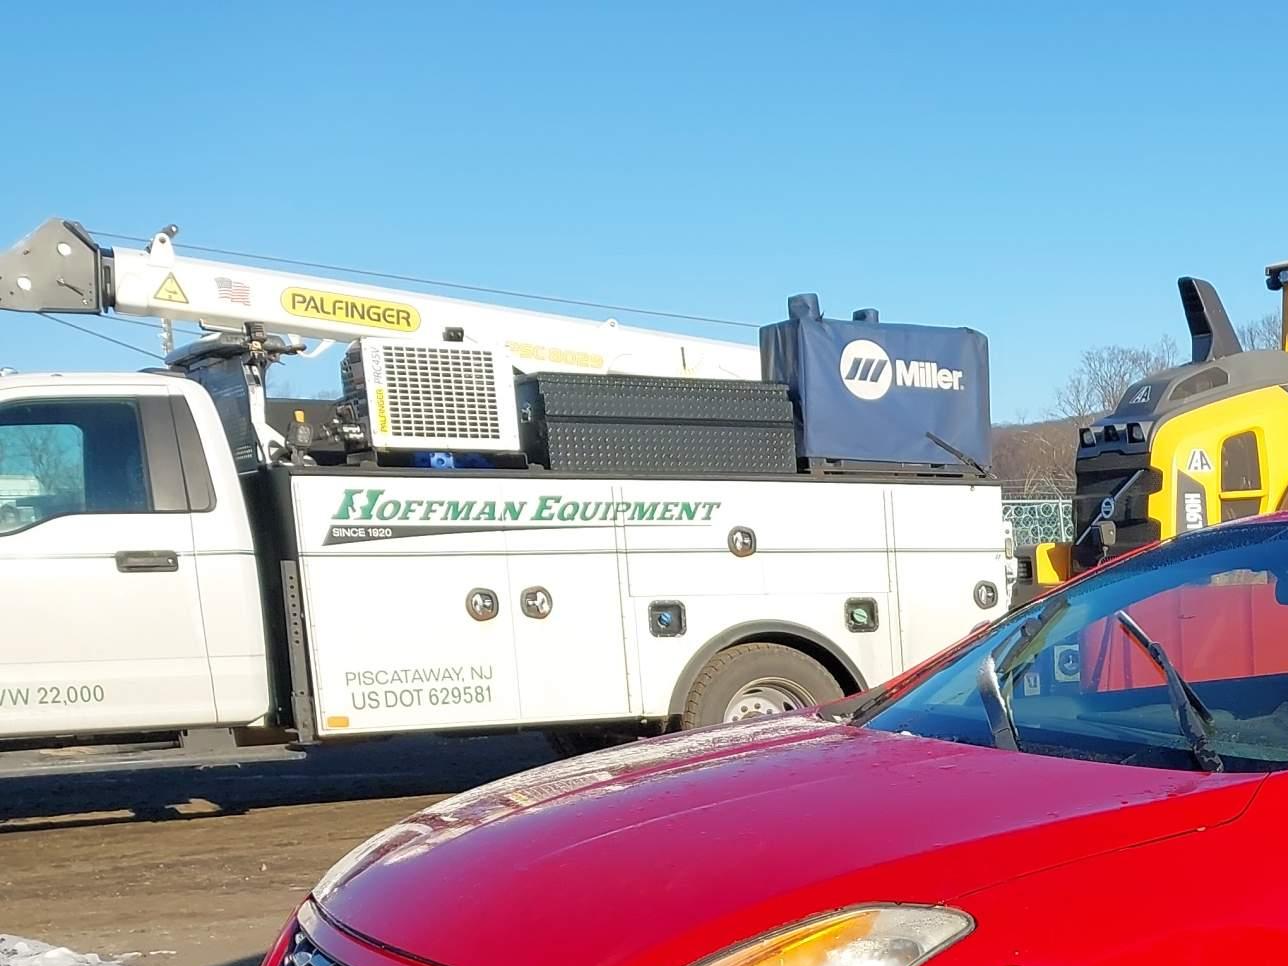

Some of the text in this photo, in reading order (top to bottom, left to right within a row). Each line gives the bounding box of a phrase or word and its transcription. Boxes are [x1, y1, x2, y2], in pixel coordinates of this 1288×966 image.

[291, 293, 412, 327] PALFINGER
[331, 489, 722, 522] HOFFMAN EQUIPMENT
[1184, 493, 1203, 529] L90H
[332, 528, 392, 537] SINCE 1920
[345, 665, 493, 687] PISCATAWAY, NJ
[37, 684, 105, 706] 22,000
[352, 685, 492, 710] US DOT 629581
